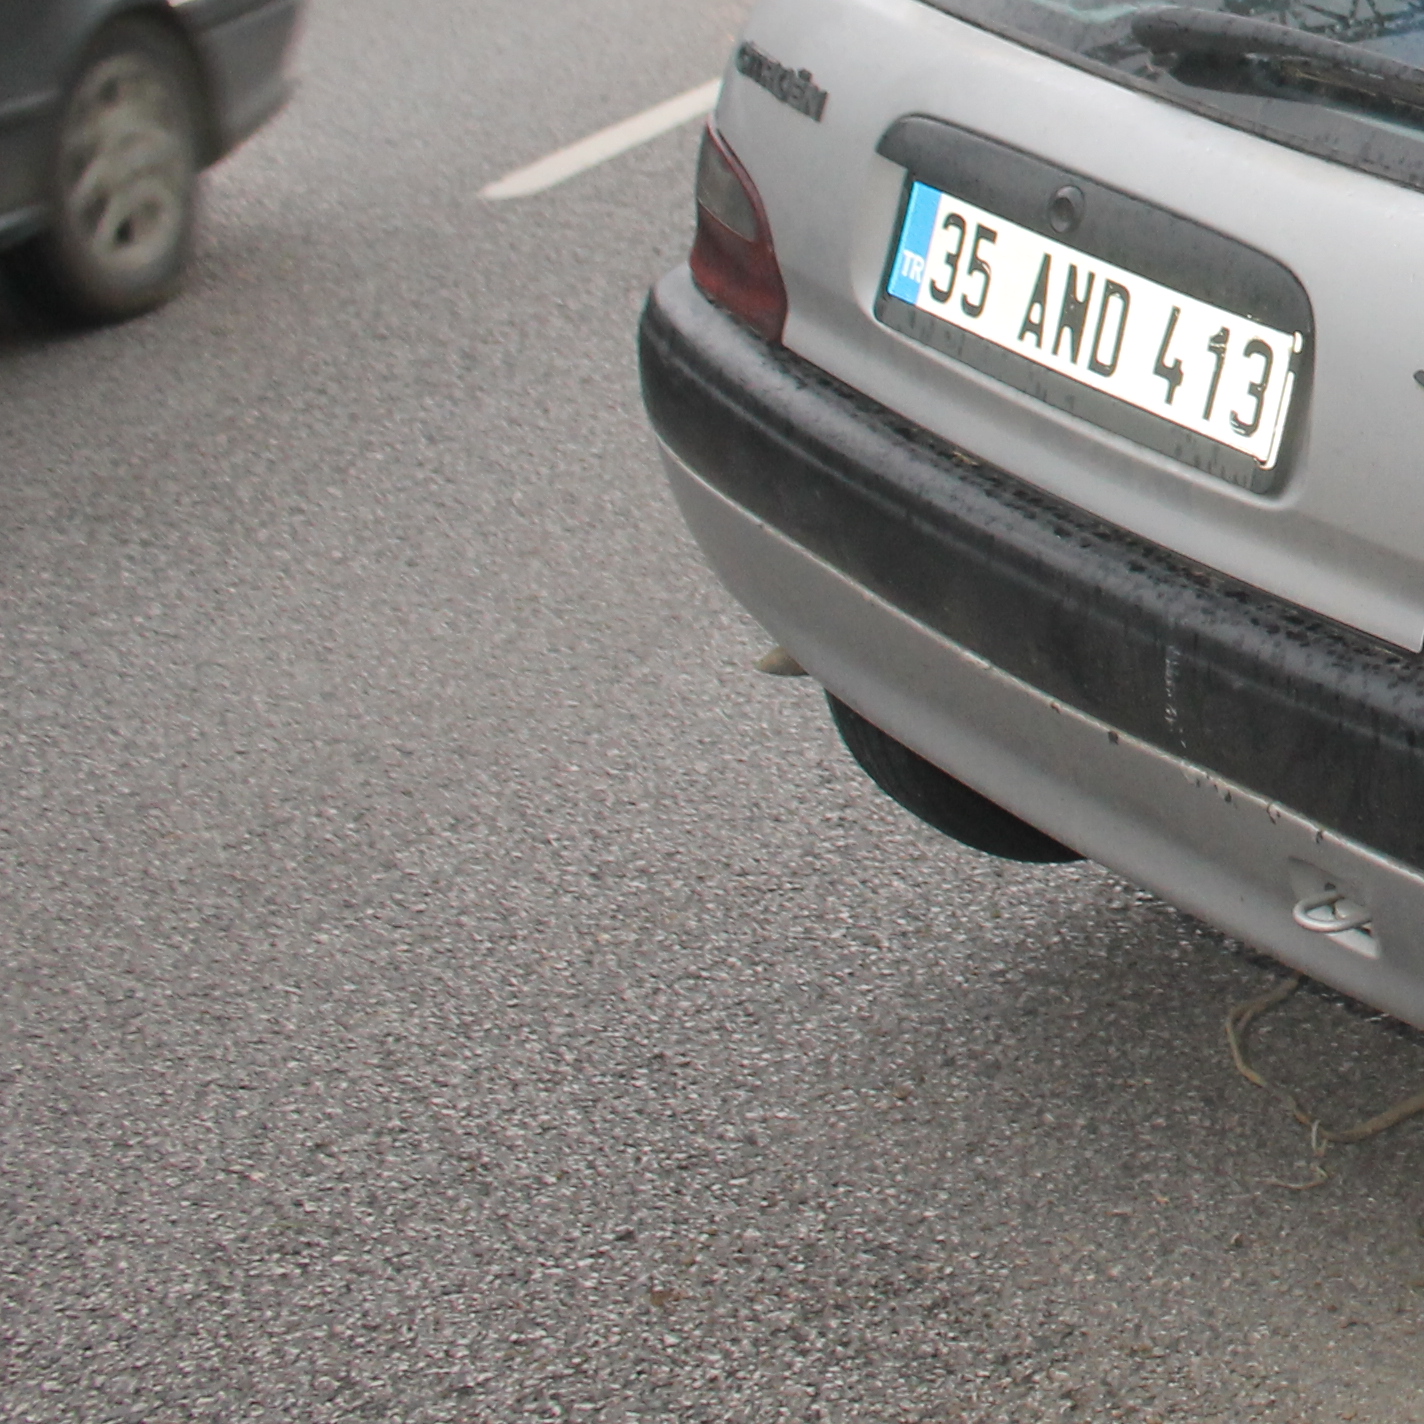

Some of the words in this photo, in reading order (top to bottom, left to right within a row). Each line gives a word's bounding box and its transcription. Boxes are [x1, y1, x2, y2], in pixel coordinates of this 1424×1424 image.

[901, 249, 925, 284] TR
[929, 212, 998, 318] 35
[1018, 252, 1131, 378] AND
[1153, 305, 1274, 437] 413
